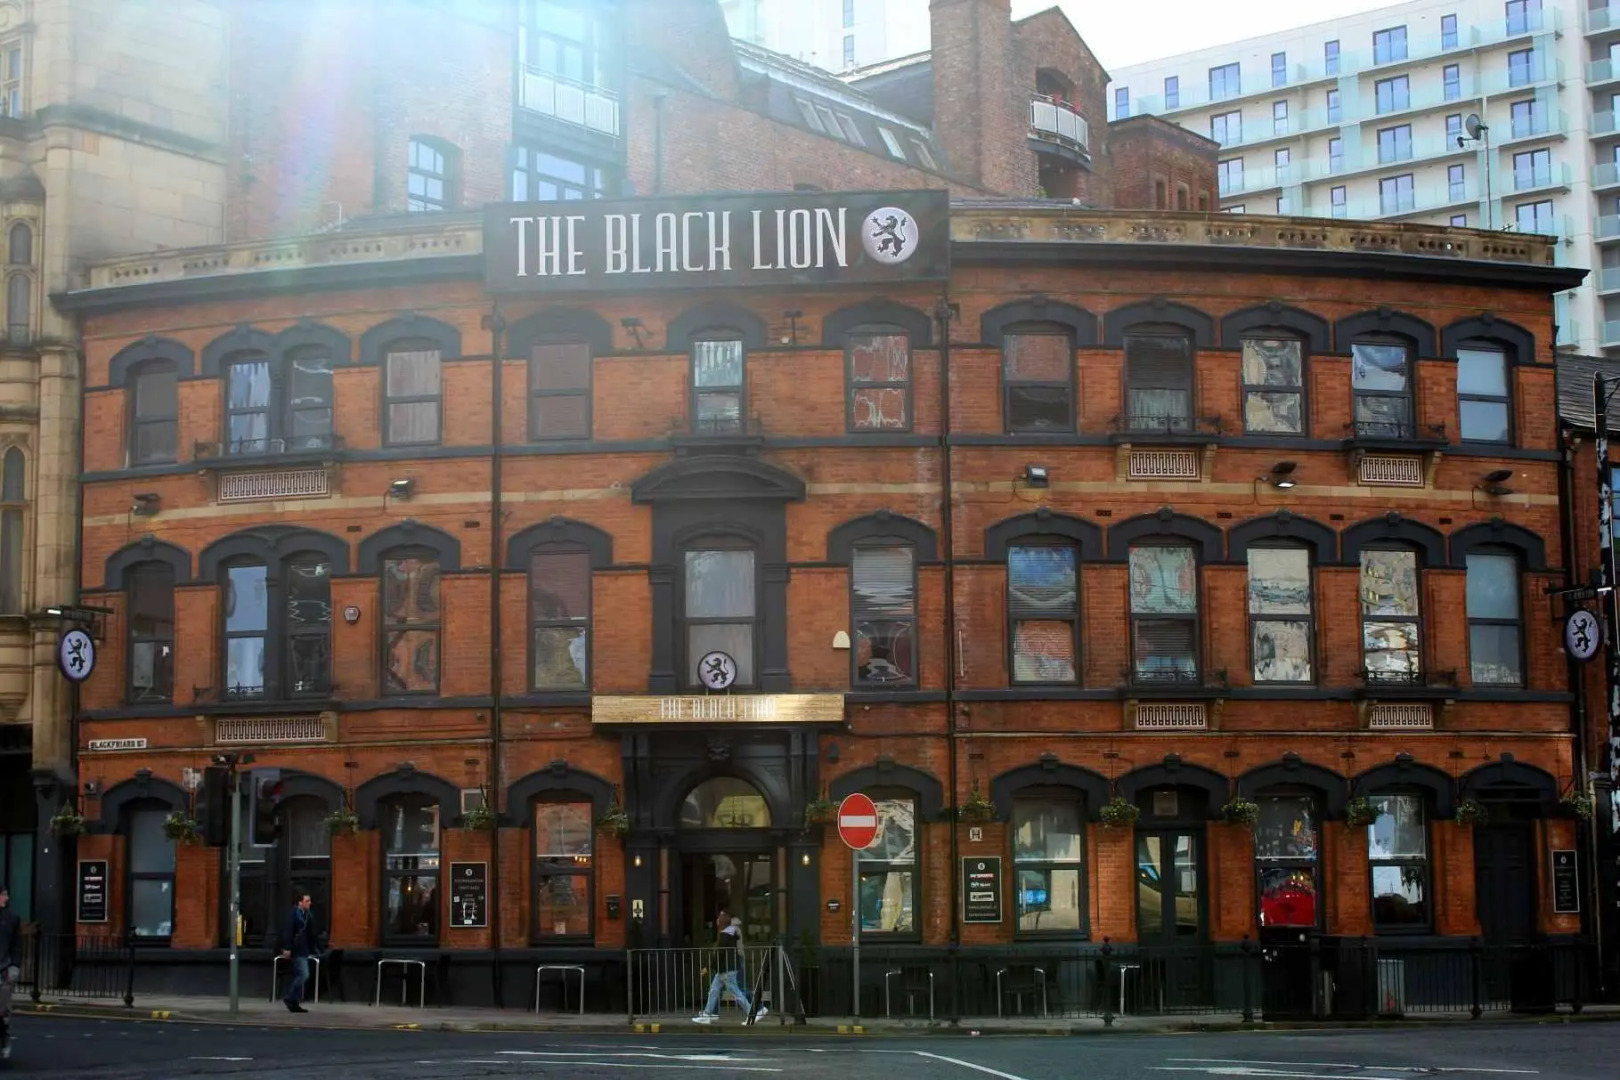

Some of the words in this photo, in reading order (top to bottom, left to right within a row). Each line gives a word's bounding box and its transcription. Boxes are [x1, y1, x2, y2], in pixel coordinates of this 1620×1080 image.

[510, 215, 586, 277] THE
[604, 210, 733, 274] BLACK
[750, 207, 849, 271] LION
[90, 740, 135, 749] BLACKFRIARS
